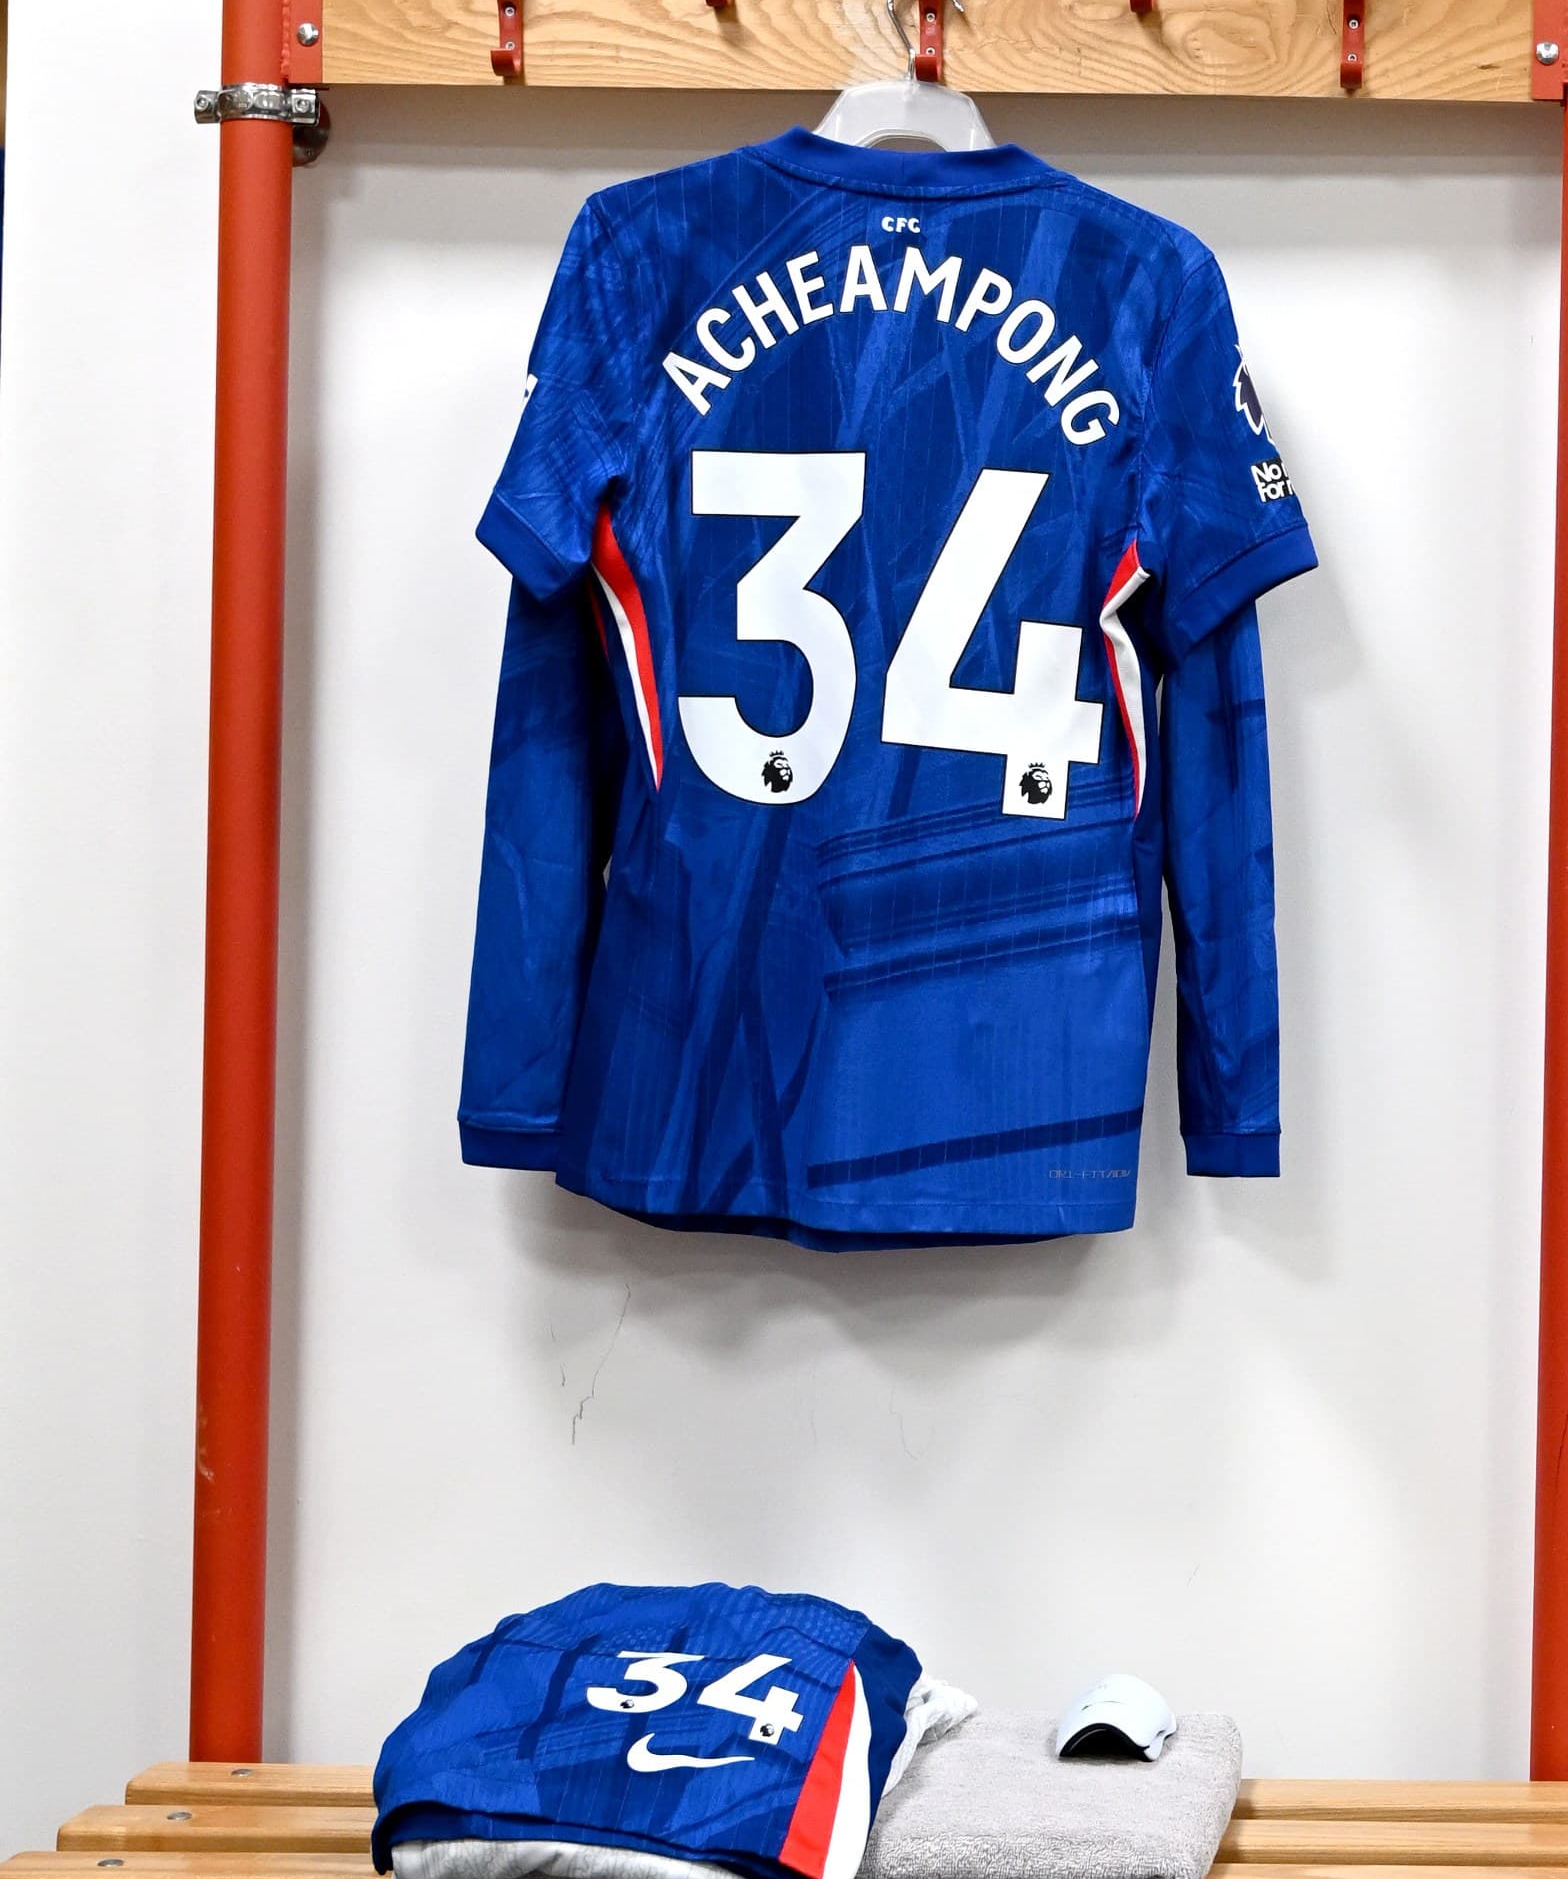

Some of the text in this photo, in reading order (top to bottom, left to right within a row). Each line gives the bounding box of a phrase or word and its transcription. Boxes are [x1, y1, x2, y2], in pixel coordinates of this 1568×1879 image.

[881, 216, 921, 234] CFC
[661, 245, 1121, 446] ACHEAMPONG
[1251, 462, 1282, 484] No
[1257, 481, 1285, 502] for
[678, 450, 1104, 820] 34
[586, 1651, 805, 1745] 34
